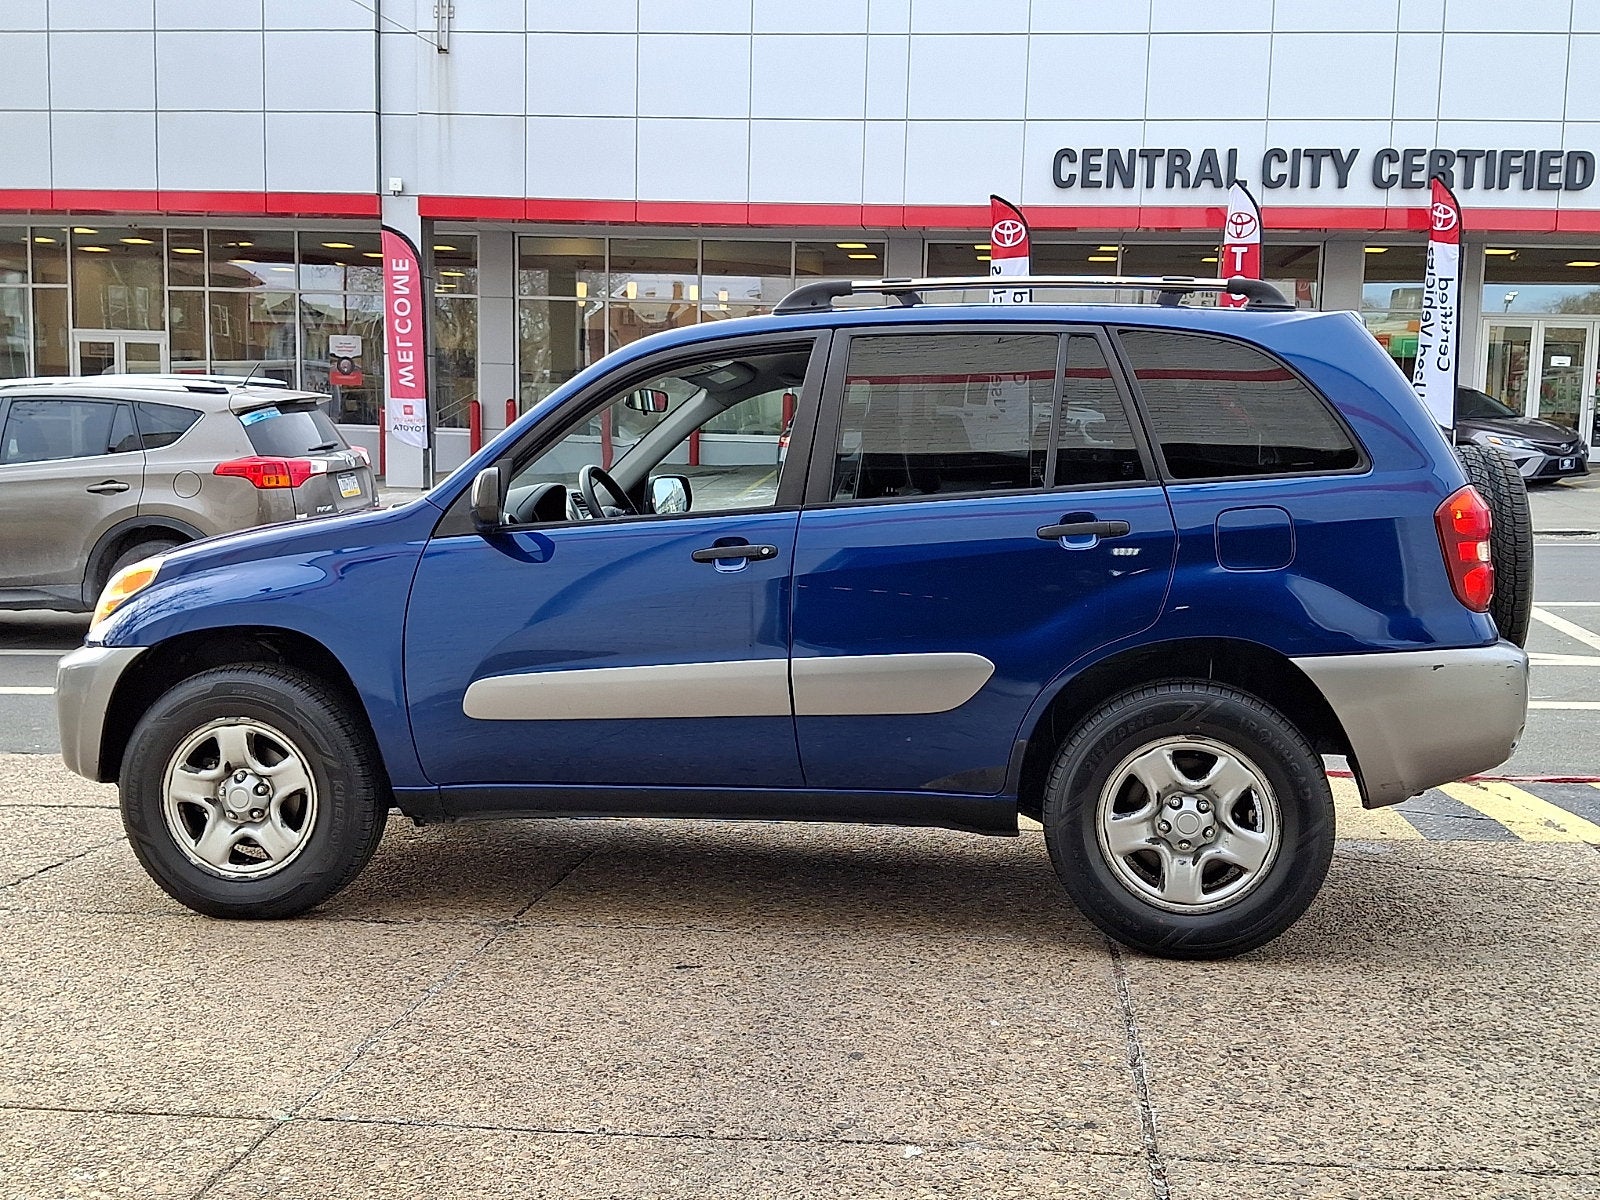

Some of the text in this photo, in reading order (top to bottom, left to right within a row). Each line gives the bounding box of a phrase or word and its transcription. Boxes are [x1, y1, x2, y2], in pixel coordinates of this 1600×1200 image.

[1052, 148, 1596, 191] CENTRAL CITY CERTIFIED
